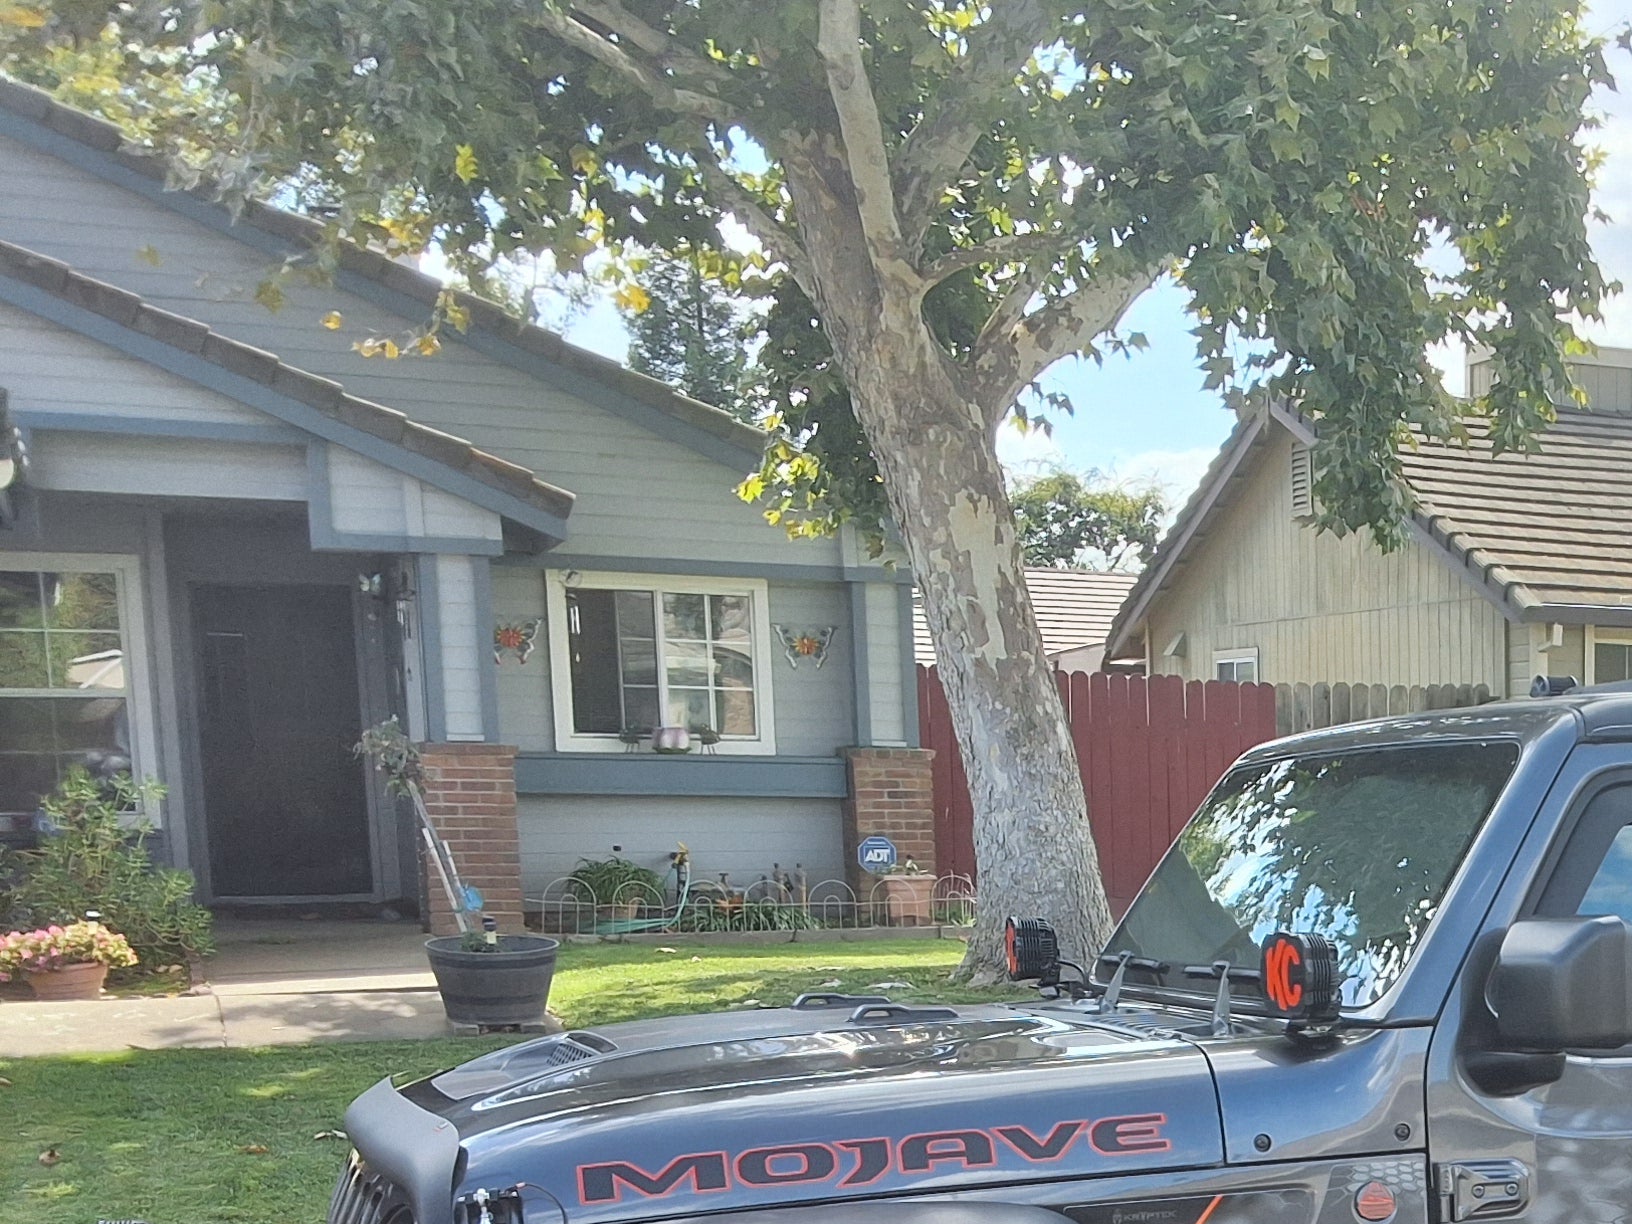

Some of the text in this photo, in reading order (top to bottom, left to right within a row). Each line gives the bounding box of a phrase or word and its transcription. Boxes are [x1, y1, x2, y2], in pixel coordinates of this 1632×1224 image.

[864, 848, 891, 863] ADT
[1264, 938, 1303, 1011] KC
[577, 1113, 1173, 1205] MOJAVE
